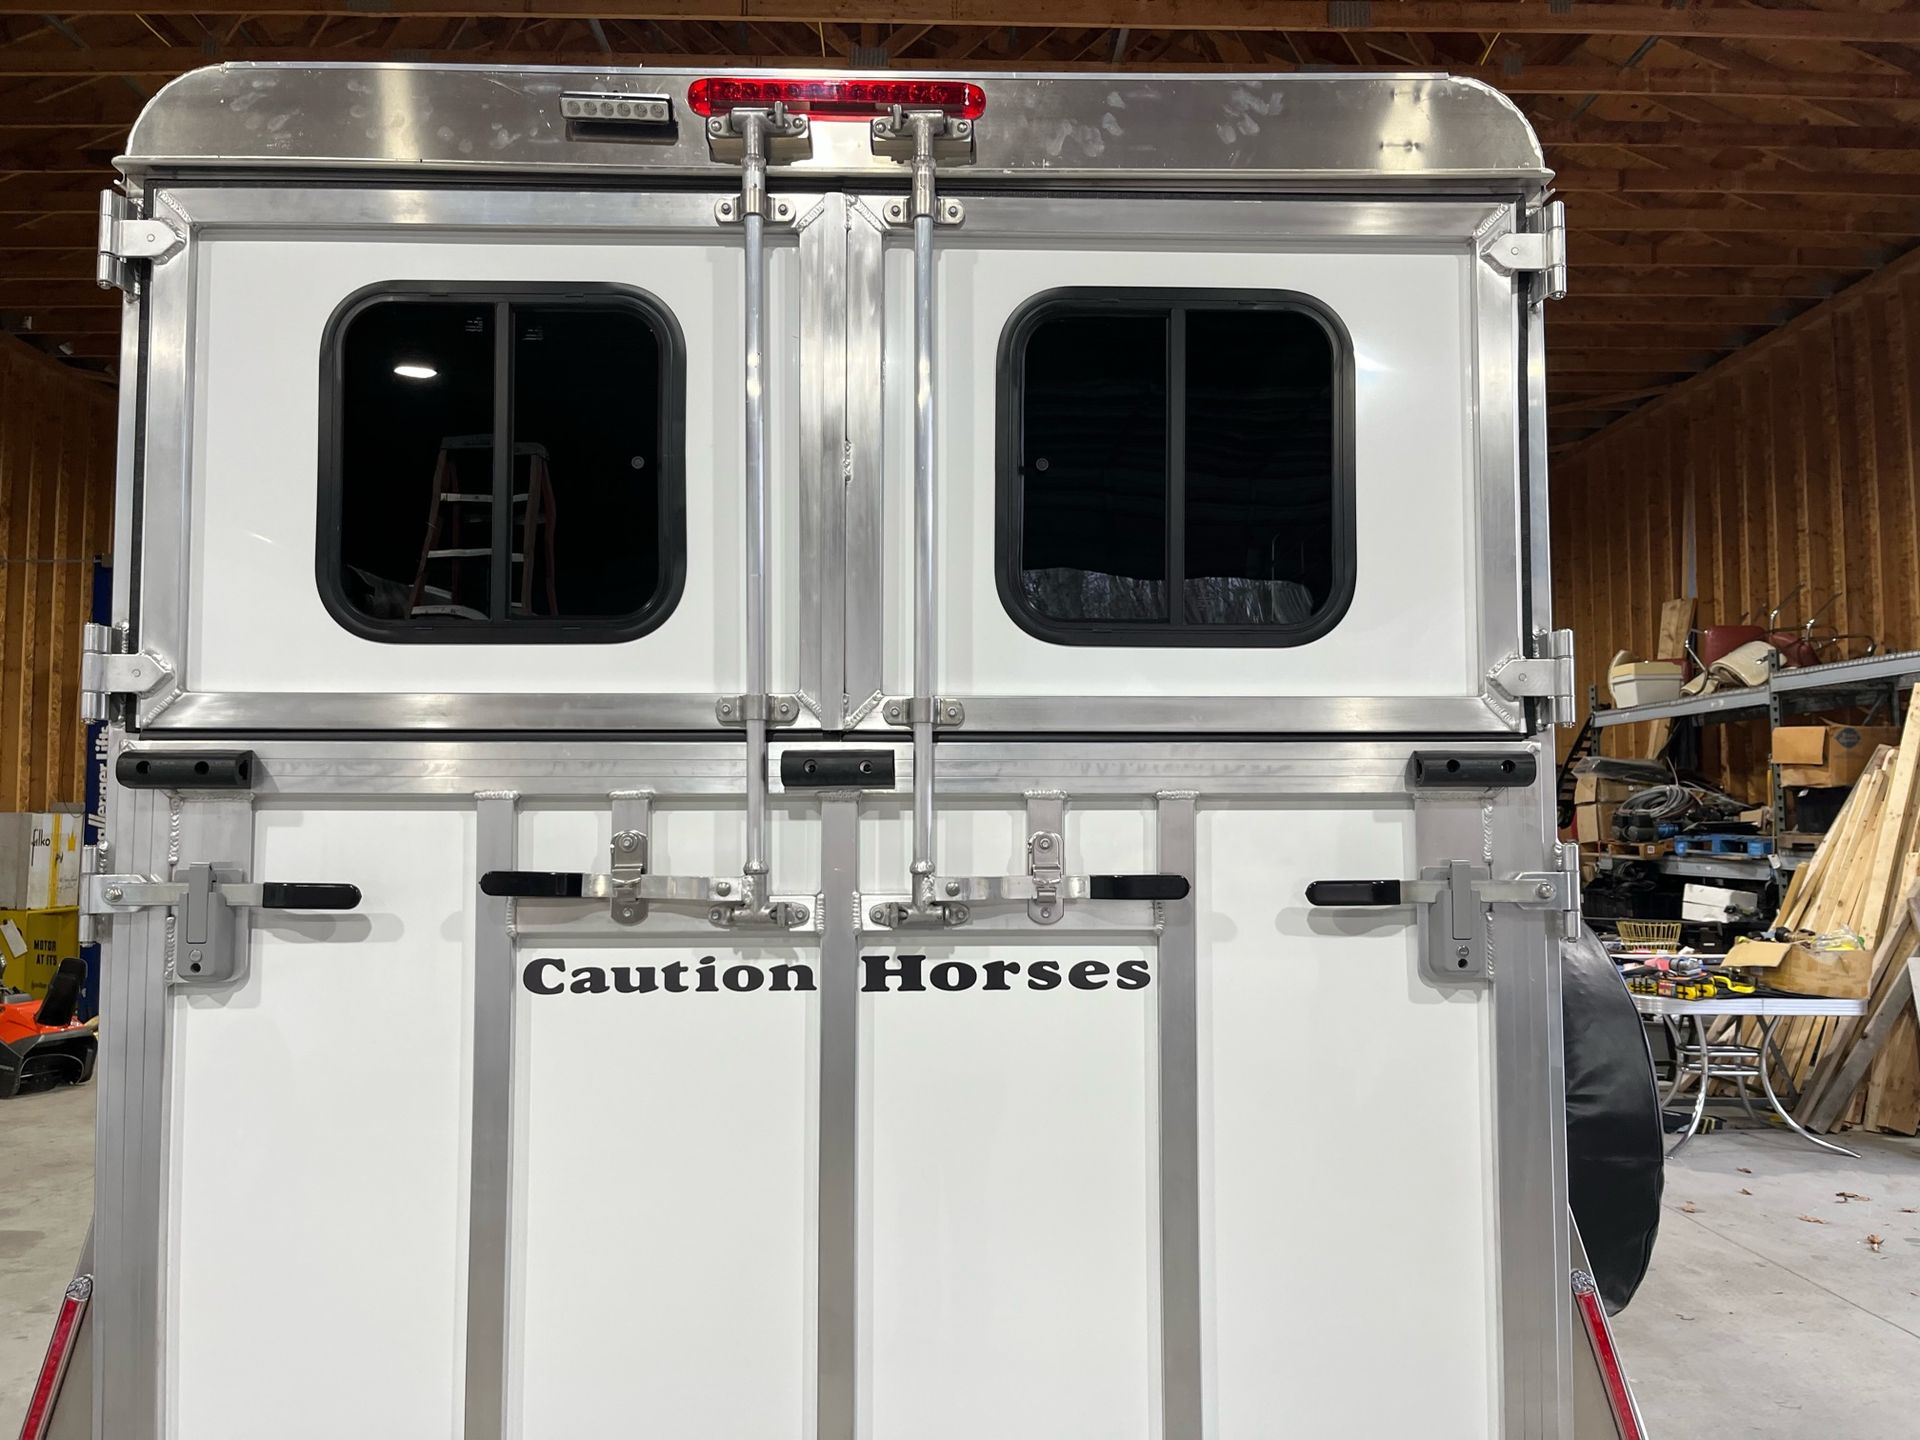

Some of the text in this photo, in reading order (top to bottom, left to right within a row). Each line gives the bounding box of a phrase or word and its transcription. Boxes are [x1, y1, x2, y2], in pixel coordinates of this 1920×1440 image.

[33, 939, 57, 952] MOTOR
[36, 954, 45, 965] AT
[522, 954, 1151, 995] Caution Horses
